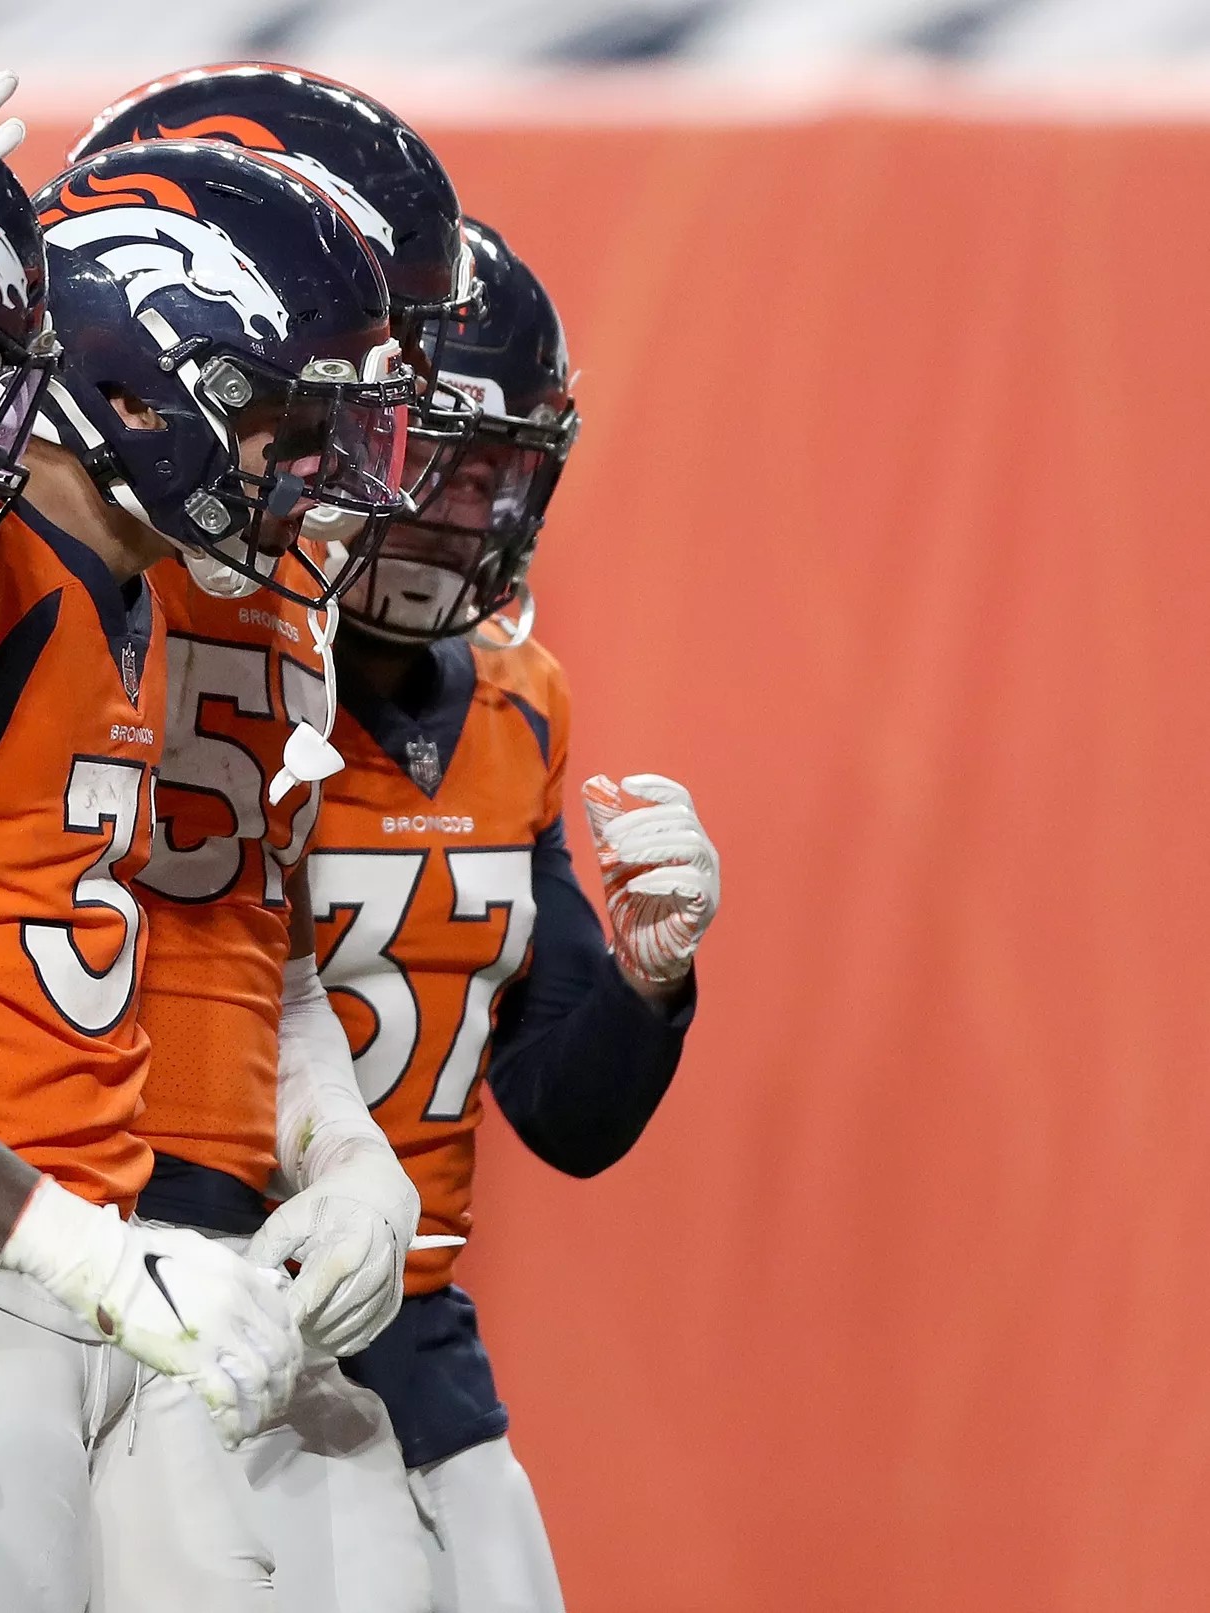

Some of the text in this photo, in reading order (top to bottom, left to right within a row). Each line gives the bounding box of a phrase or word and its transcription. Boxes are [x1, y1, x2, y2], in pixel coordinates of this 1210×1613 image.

[238, 607, 299, 643] BRONCOS
[110, 724, 154, 745] BRONCOS
[381, 815, 474, 833] BRONCOS
[20, 752, 158, 1036] 3
[308, 846, 536, 1123] 37
